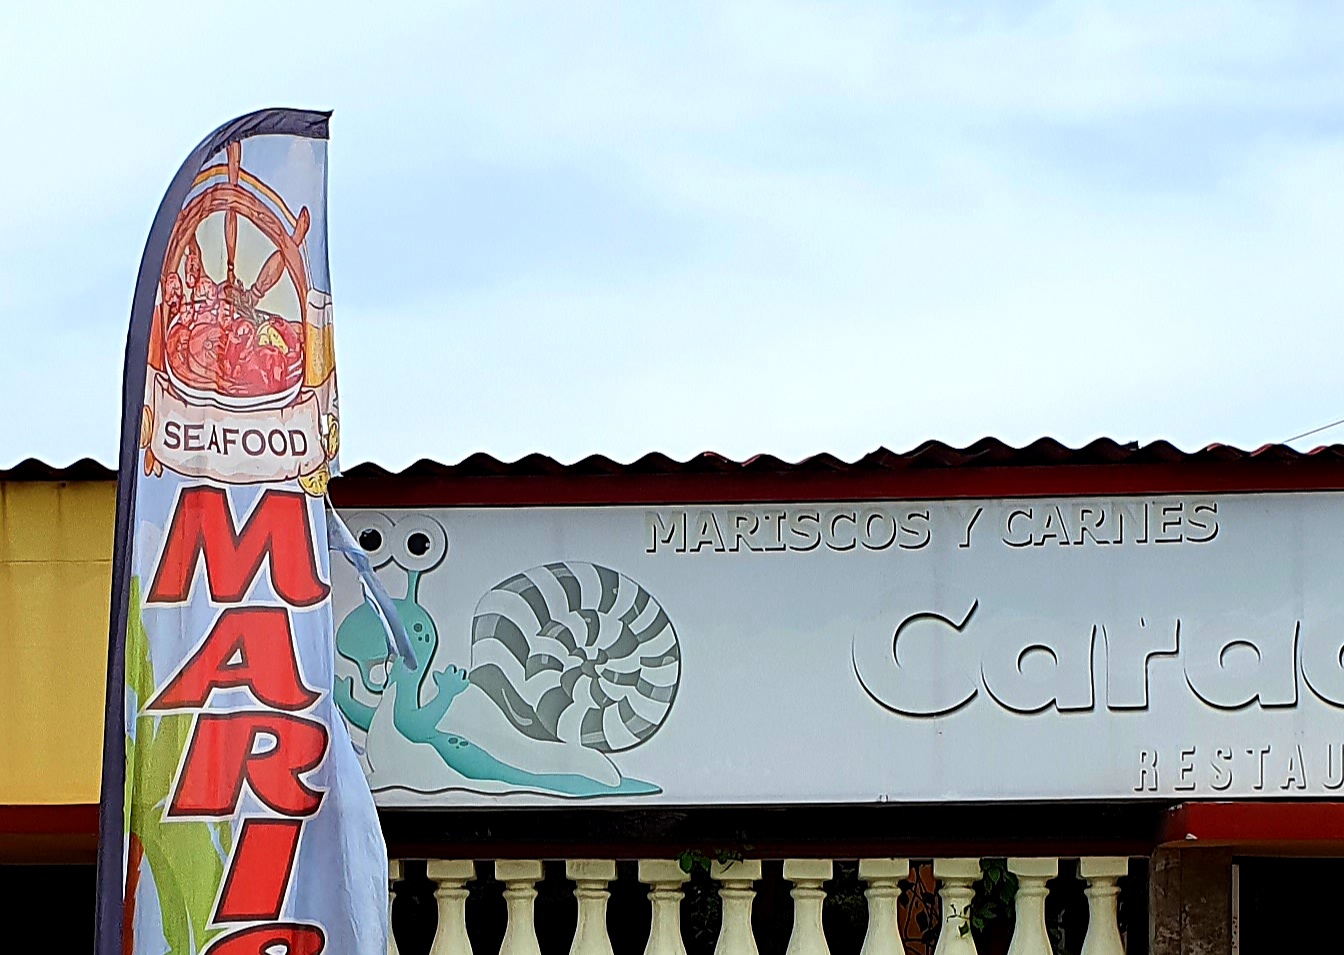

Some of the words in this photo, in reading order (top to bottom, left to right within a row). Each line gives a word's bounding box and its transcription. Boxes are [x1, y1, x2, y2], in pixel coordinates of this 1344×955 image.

[162, 420, 309, 458] SEAFOOD
[644, 506, 932, 553] MARISCOS
[949, 502, 984, 548] Y
[1000, 501, 1219, 548] CARNES
